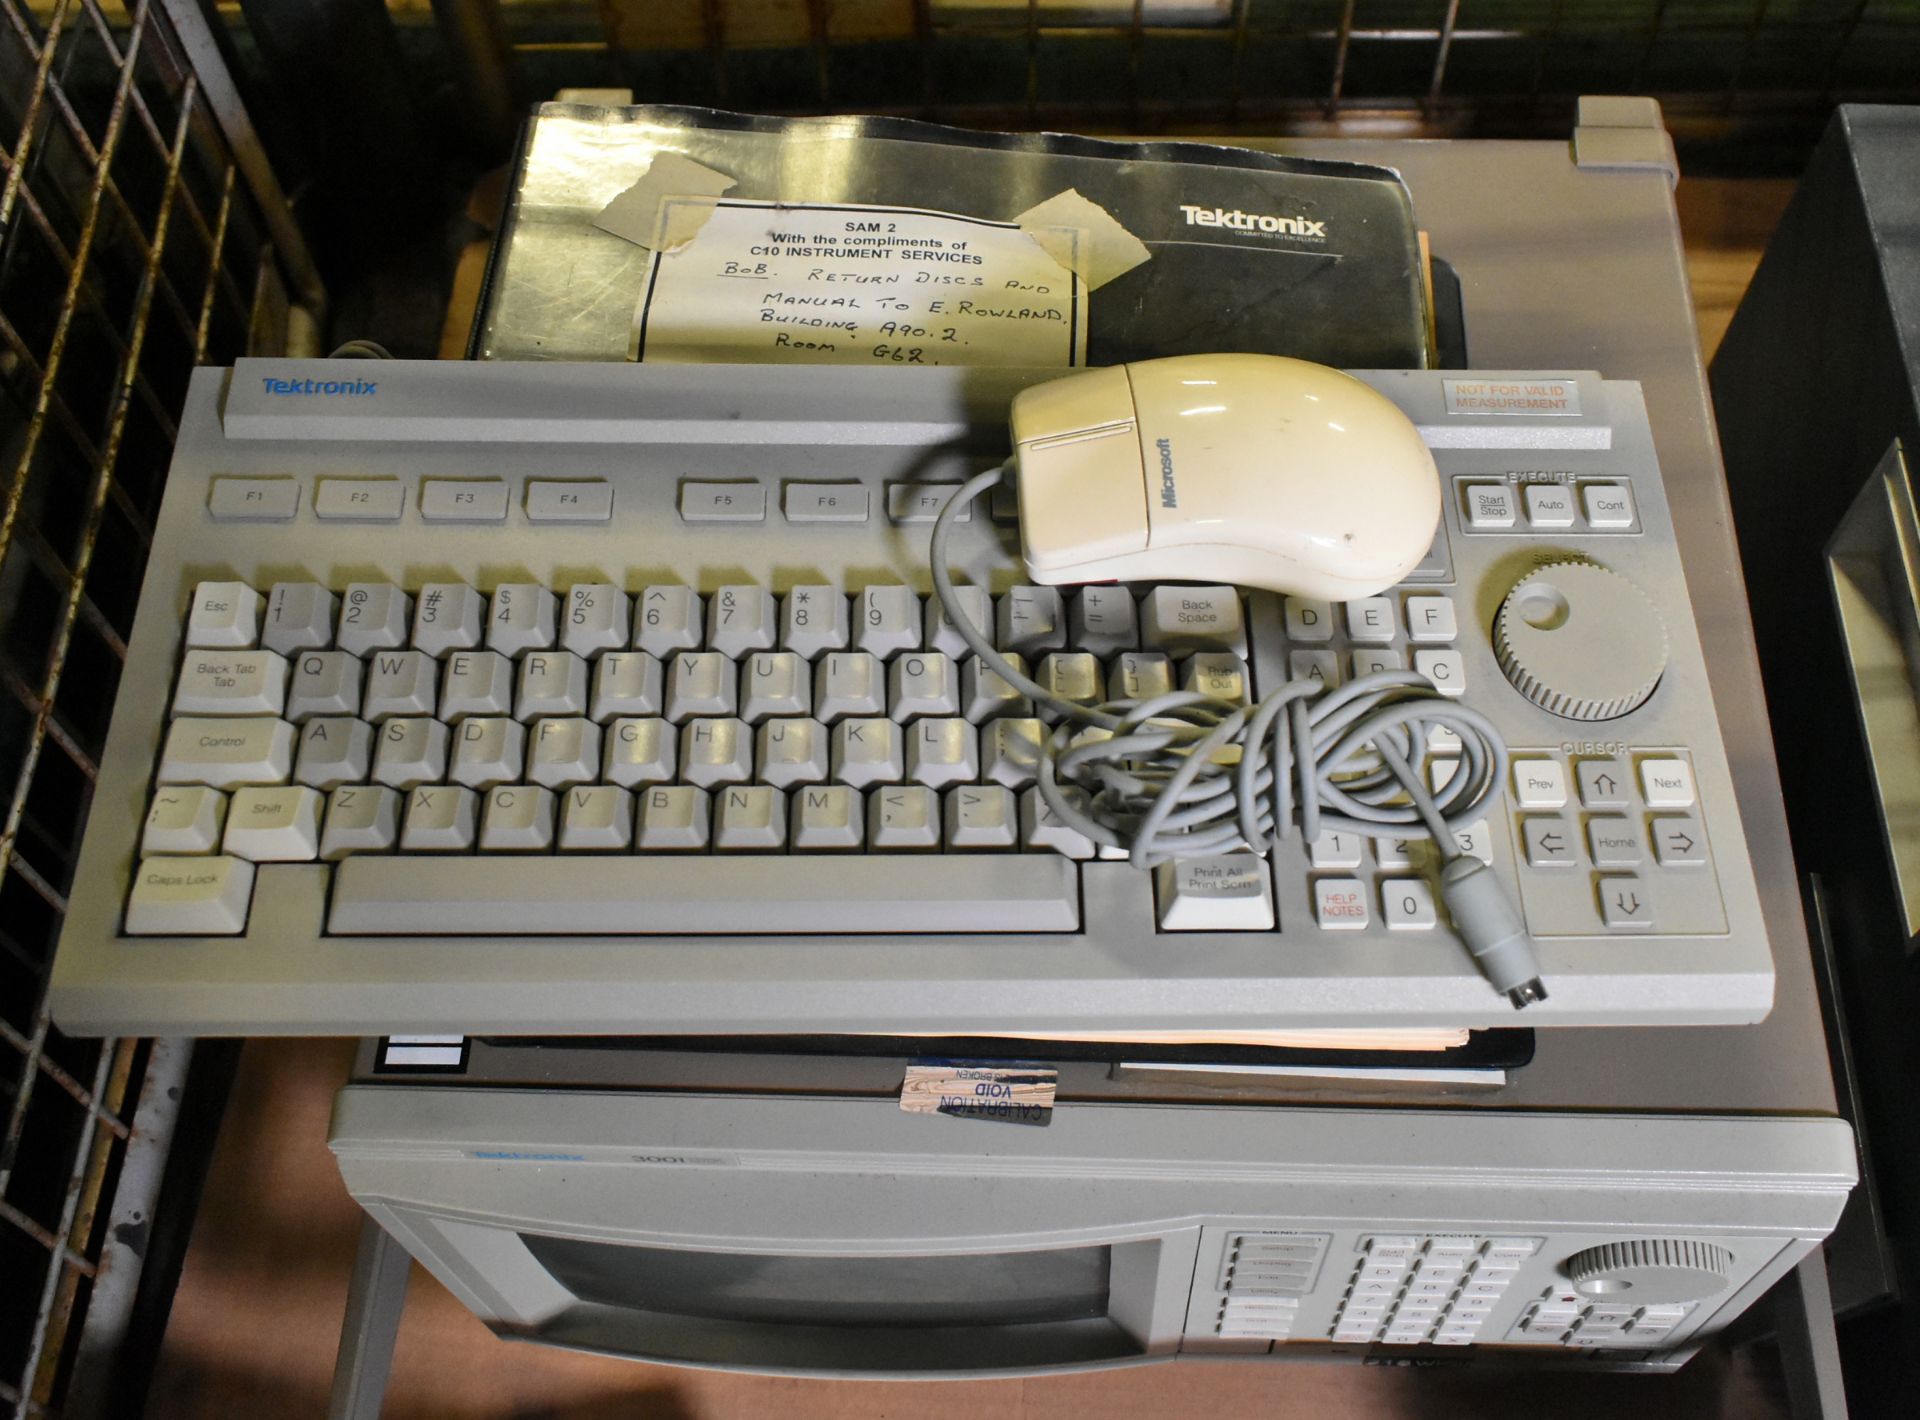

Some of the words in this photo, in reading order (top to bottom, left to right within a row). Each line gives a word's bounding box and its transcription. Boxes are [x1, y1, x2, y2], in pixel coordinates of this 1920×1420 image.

[845, 222, 881, 232] SAM
[888, 223, 897, 232] 2
[1180, 205, 1326, 237] Tektronix
[771, 233, 806, 244] With
[813, 234, 837, 245] the
[844, 235, 943, 249] compliments
[952, 242, 968, 251] of
[750, 246, 780, 256] C10
[786, 247, 893, 259] INSTRUMENT
[901, 250, 983, 265] SERVICES
[807, 269, 900, 284] RETURN
[915, 272, 984, 286] DISCS
[762, 292, 861, 309] MANUAL
[263, 378, 377, 395] Tektronix
[1456, 385, 1486, 396] NOT
[1490, 385, 1520, 396] FOR
[1524, 386, 1564, 397] VALID
[1456, 398, 1568, 409] MEASUREMENT
[1156, 438, 1177, 508] Microsoft
[1506, 471, 1577, 484] EXECUTE
[246, 491, 263, 501] F1
[351, 493, 369, 503] F2
[455, 494, 475, 504] F3
[560, 495, 578, 505] F4
[714, 496, 732, 505] F5
[818, 497, 836, 507] F6
[921, 497, 939, 507] F7
[1478, 495, 1505, 505] Start
[1480, 506, 1507, 517] Stop
[1538, 500, 1564, 510] Auto
[1597, 500, 1624, 510] Cont
[350, 590, 368, 605] @
[500, 590, 512, 605] $
[575, 591, 595, 608] %
[722, 591, 736, 607] &
[1182, 600, 1213, 610] Back
[204, 601, 228, 612] Esc
[274, 607, 282, 622] 1
[346, 607, 361, 623] 2
[422, 607, 436, 623] 3
[498, 608, 511, 624] 4
[572, 608, 586, 624] 5
[647, 608, 660, 625] 6
[723, 609, 734, 625] 7
[796, 609, 808, 626] 8
[869, 609, 882, 626] 9
[1178, 612, 1217, 625] Space
[1302, 609, 1318, 625] D
[1365, 610, 1379, 625] E
[1425, 609, 1437, 624] F
[197, 663, 229, 674] Back
[235, 663, 256, 674] Tab
[304, 657, 323, 676] Q
[380, 658, 404, 675] W
[454, 658, 470, 675] E
[530, 658, 547, 675] R
[608, 658, 622, 675] T
[683, 659, 699, 676] Y
[757, 659, 774, 677] U
[906, 659, 925, 677] O
[1308, 664, 1325, 680] A
[1432, 663, 1450, 680] C
[213, 677, 236, 688] Tab
[309, 724, 328, 741] A
[388, 724, 405, 742] S
[465, 724, 484, 741] D
[540, 724, 555, 742] F
[620, 725, 639, 743] G
[695, 726, 712, 742] H
[772, 725, 785, 742] J
[848, 725, 864, 742] K
[925, 726, 938, 742] L
[199, 736, 245, 748] Control
[1560, 742, 1629, 756] CURSOR
[1528, 778, 1554, 789] Prev
[1654, 778, 1682, 789] Next
[337, 791, 356, 808] Z
[415, 791, 435, 808] X
[496, 791, 515, 808] C
[575, 791, 592, 808] V
[652, 791, 669, 808] B
[730, 792, 748, 808] N
[808, 792, 828, 808] M
[251, 803, 282, 815] Shift
[1331, 835, 1340, 852] 1
[1459, 834, 1474, 851] 3
[1599, 838, 1636, 848] Home
[147, 873, 182, 886] Caps
[186, 873, 217, 885] Lock
[1194, 867, 1222, 877] Print
[1189, 878, 1217, 889] Print
[1325, 894, 1357, 904] HELP
[1322, 905, 1365, 917] NOTES
[956, 1069, 992, 1081] BROKEN
[975, 1083, 1012, 1098] VOID
[940, 1095, 1042, 1121] CALIBRATION
